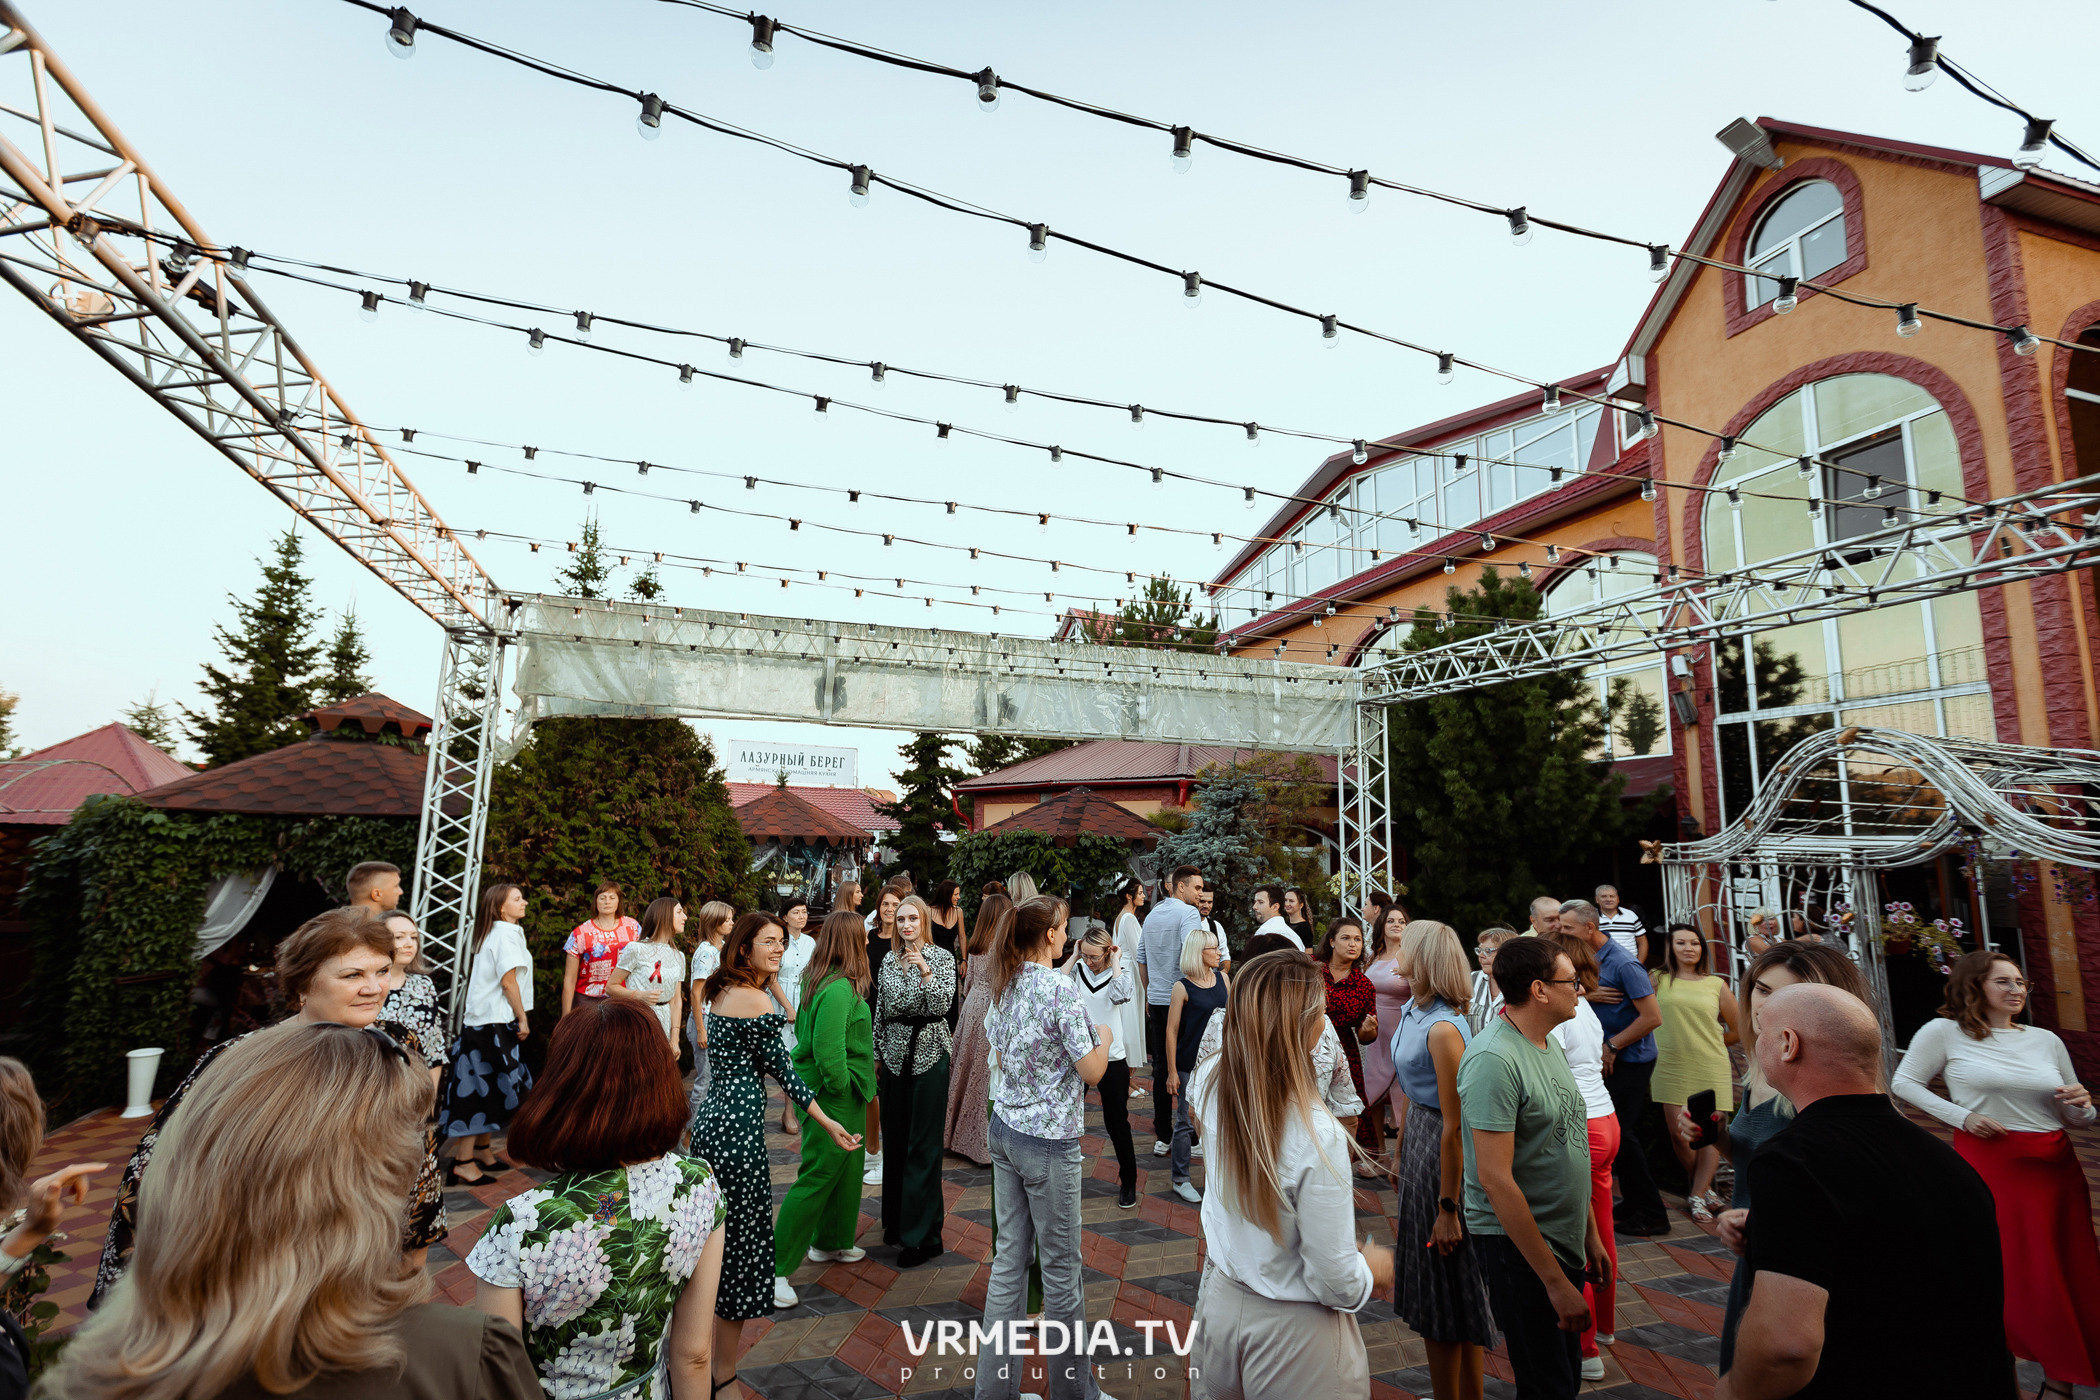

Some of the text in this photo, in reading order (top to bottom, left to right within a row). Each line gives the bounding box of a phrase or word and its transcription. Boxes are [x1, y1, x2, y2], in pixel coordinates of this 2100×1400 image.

[740, 751, 846, 769] ЛАЗУРНЫЙ БЕРЕГ
[748, 766, 783, 774] АРМЯНСКА
